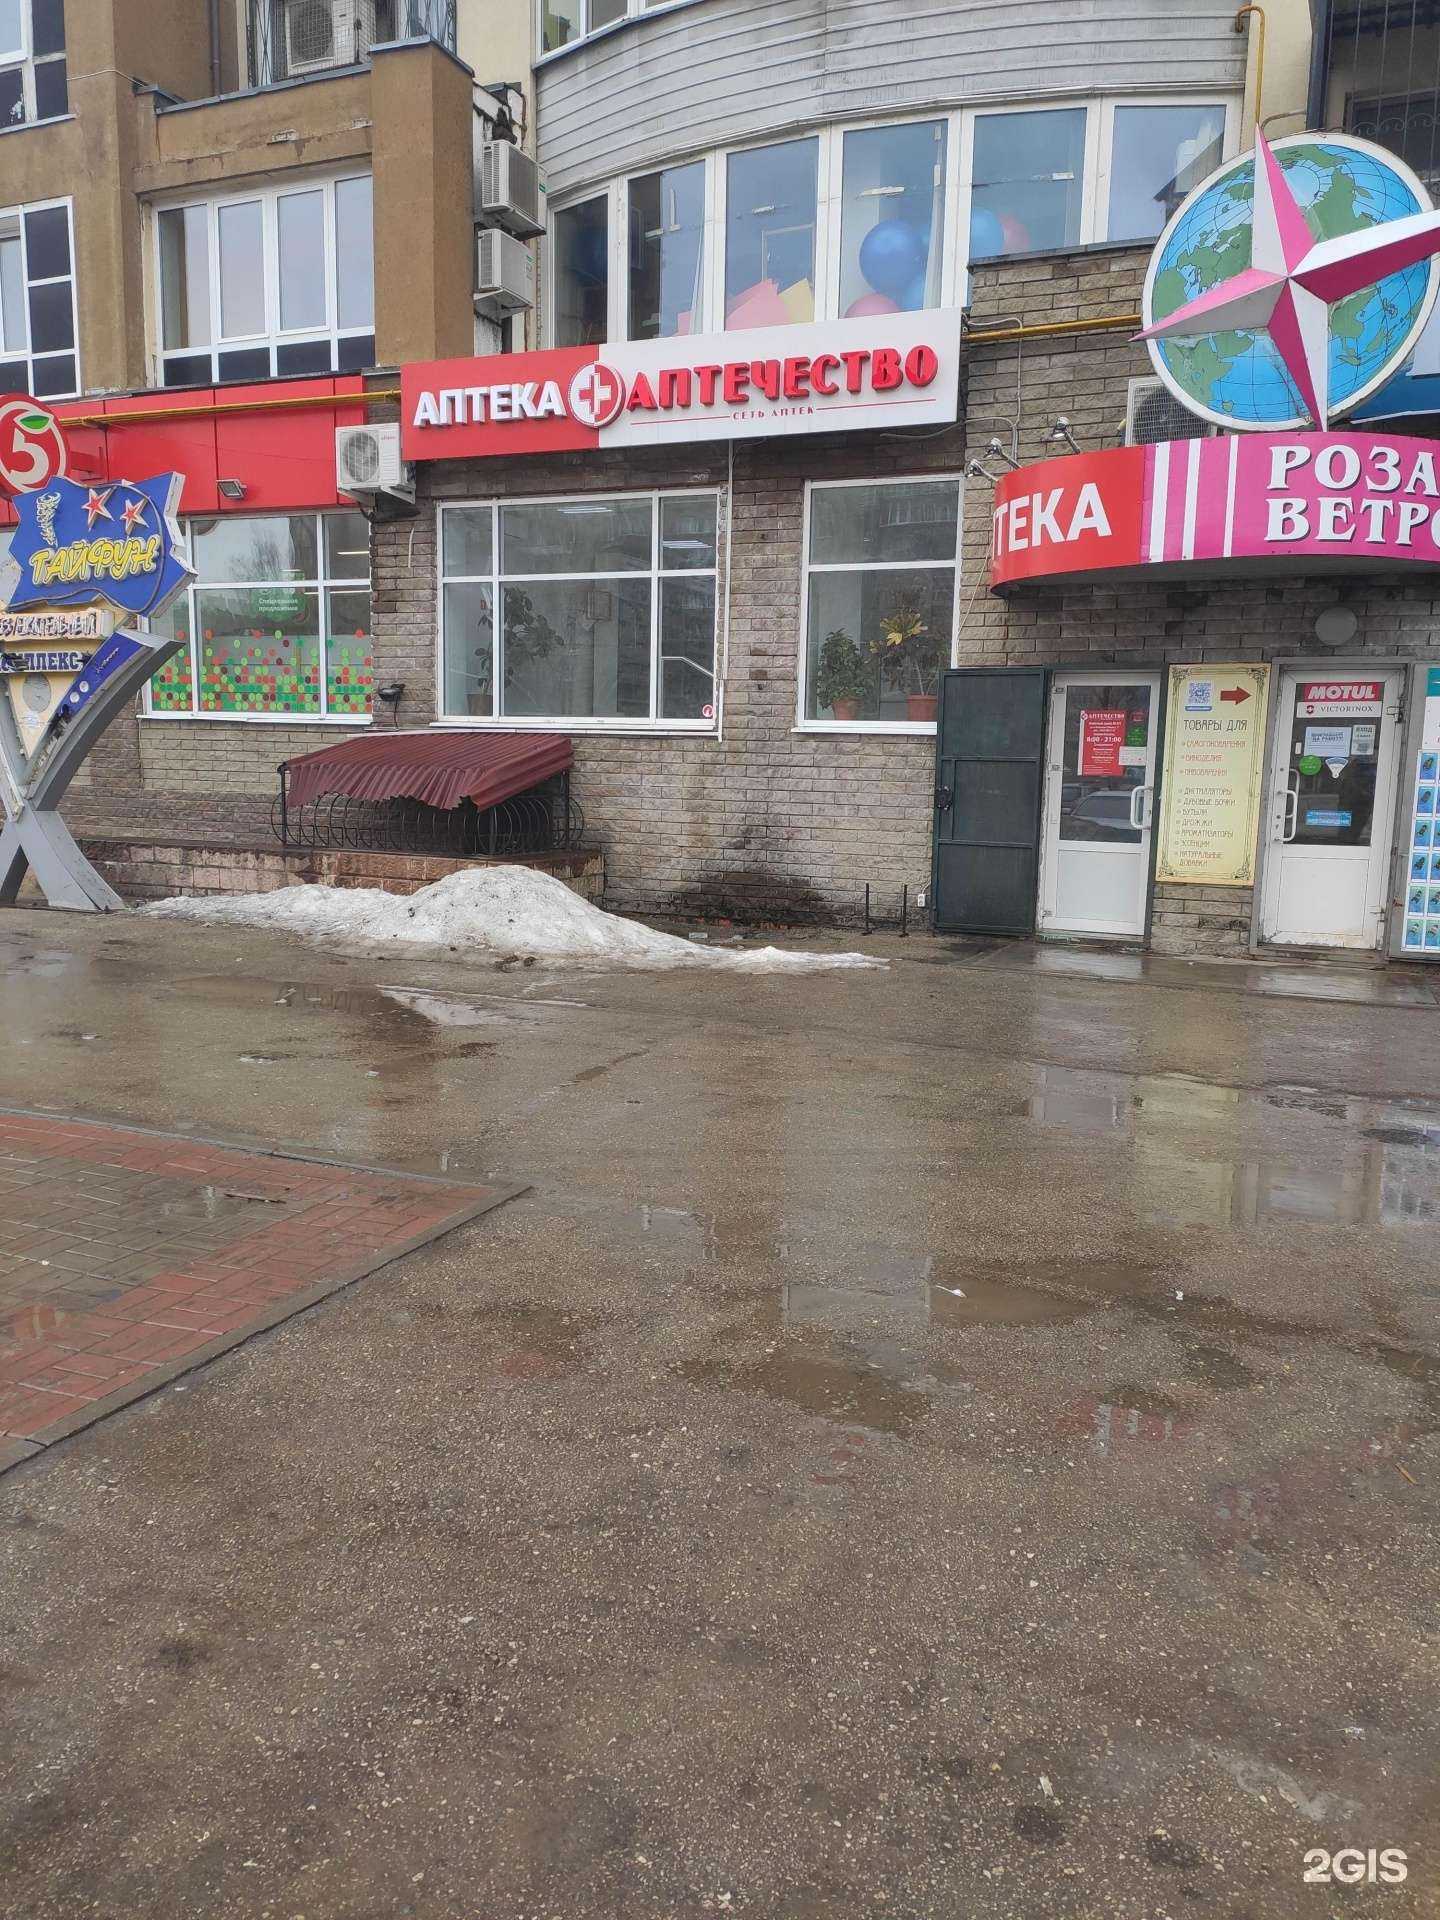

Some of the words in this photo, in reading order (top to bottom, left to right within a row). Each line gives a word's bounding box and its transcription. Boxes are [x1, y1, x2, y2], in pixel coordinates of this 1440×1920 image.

[413, 380, 567, 427] АПТЕКА
[626, 344, 938, 411] АПТЕЧЕСТВО
[733, 408, 765, 420] СЕТЬ
[771, 406, 814, 417] АПТЕК
[1267, 444, 1440, 497] РОЗА
[992, 482, 1113, 561] ТЕКА
[1264, 497, 1440, 549] ВЕТР
[29, 534, 159, 586] ТАЙФУН
[1308, 685, 1375, 700] MOTUL
[1320, 705, 1373, 713] VICTORINOX
[1184, 719, 1222, 731] ТОВАРЫ
[1226, 719, 1248, 732] ДЛЯ
